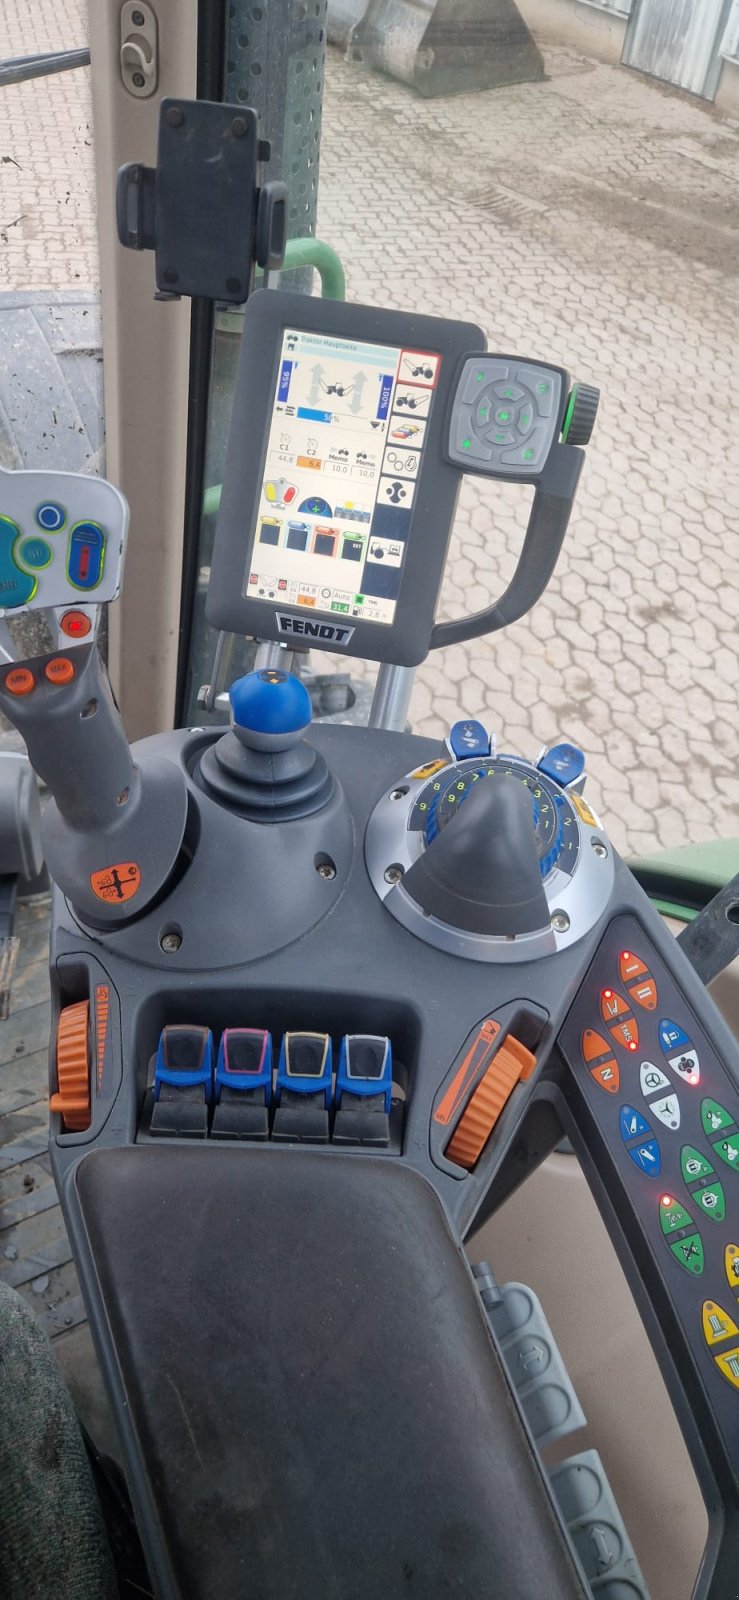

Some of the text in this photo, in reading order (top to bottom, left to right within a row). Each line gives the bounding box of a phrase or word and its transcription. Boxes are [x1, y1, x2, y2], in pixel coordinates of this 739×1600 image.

[300, 335, 358, 351] Traktor Hauptseite
[281, 371, 290, 389] 95%
[380, 387, 390, 409] 100%
[328, 454, 348, 463] Memo
[356, 459, 376, 468] Memo
[333, 592, 351, 601] Auto
[279, 617, 350, 641] FENDT
[472, 773, 479, 781] 7
[433, 782, 440, 791] 8
[457, 782, 465, 790] 8
[447, 794, 455, 802] 9
[419, 802, 427, 811] 9
[540, 805, 549, 813] 2
[563, 817, 571, 826] 2
[620, 1023, 633, 1042] TMS
[600, 1067, 613, 1081] N
